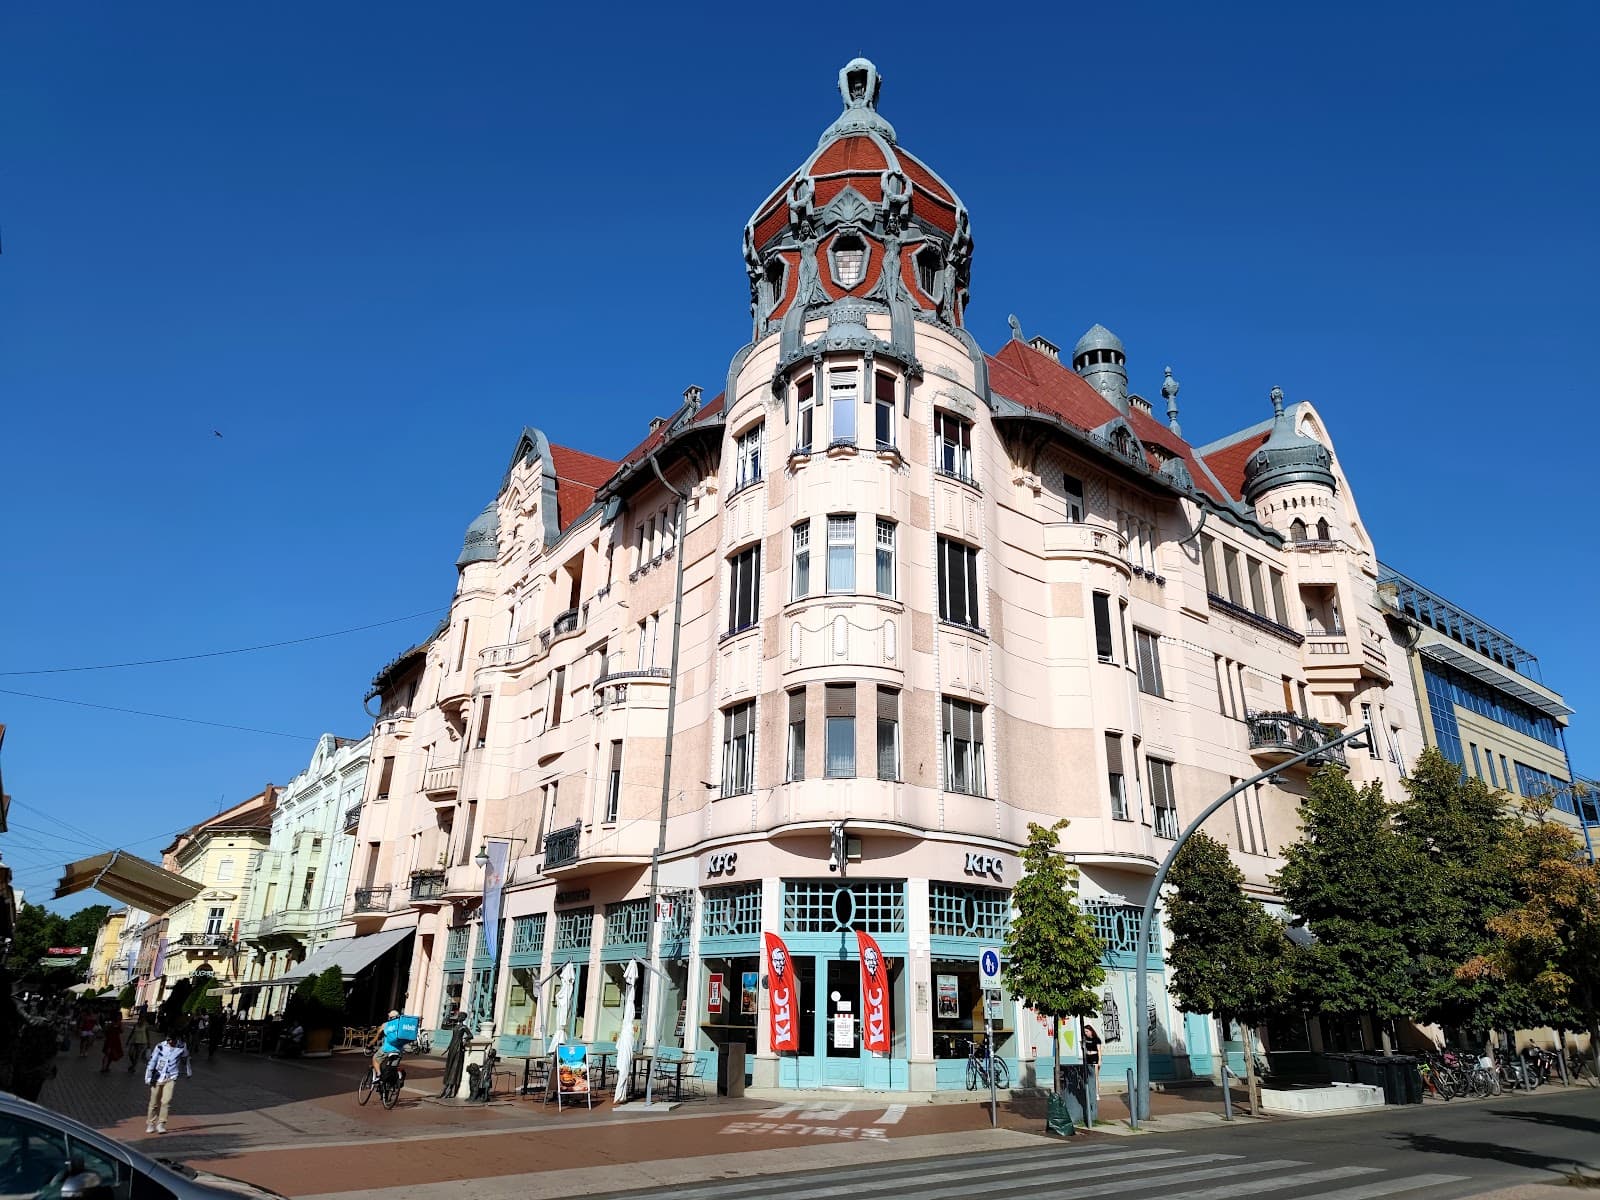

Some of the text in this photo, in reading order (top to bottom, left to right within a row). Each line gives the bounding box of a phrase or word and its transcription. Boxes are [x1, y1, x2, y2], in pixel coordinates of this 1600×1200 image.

[706, 853, 737, 873] KFC
[966, 853, 1004, 875] KFC
[774, 987, 791, 1045] KFC
[868, 987, 885, 1045] KFC
